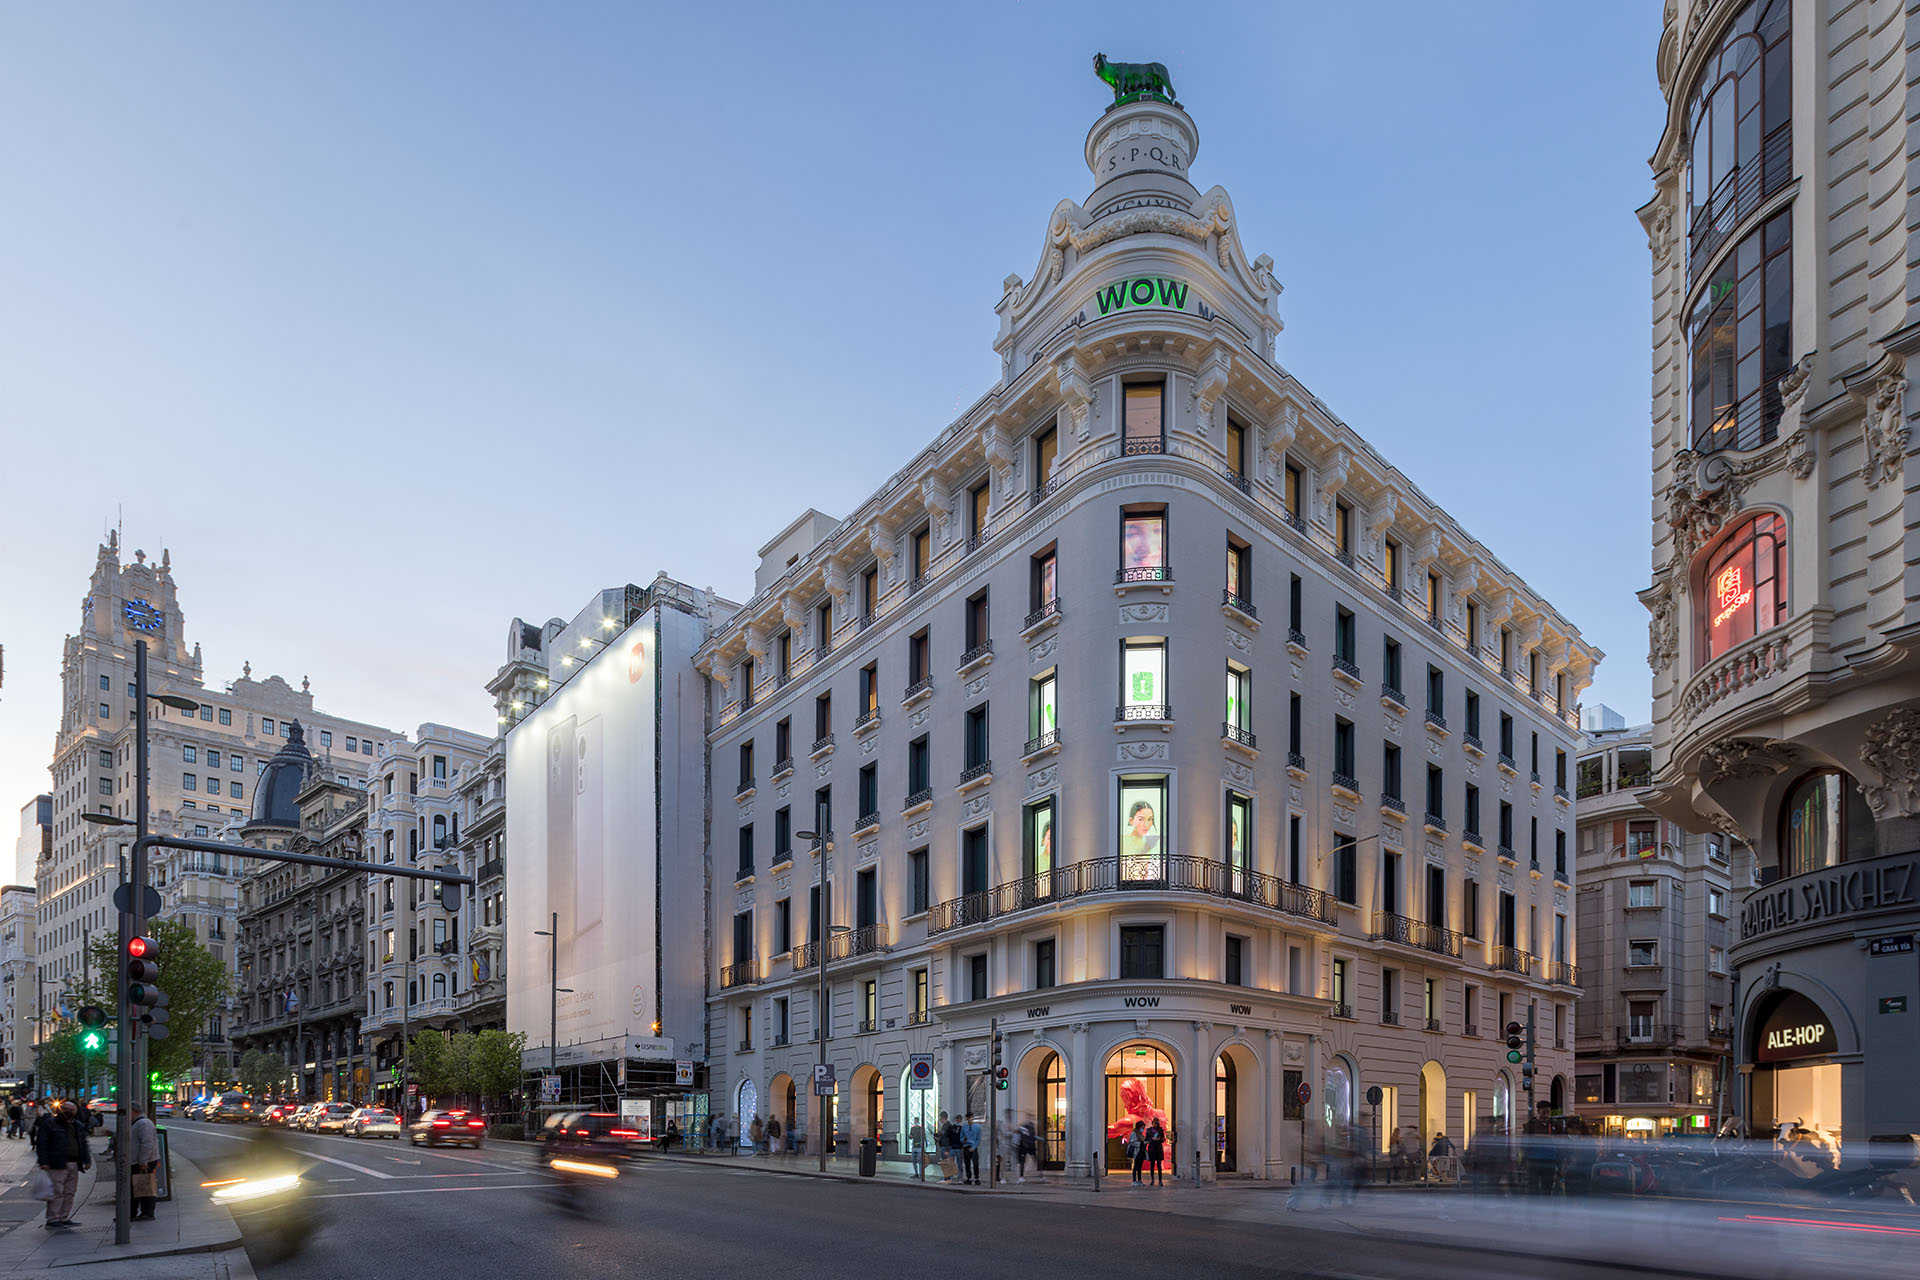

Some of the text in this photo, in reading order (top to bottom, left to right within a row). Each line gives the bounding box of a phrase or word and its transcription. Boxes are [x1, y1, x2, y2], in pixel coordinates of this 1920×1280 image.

[1095, 278, 1189, 315] WOW
[1744, 861, 1914, 938] RAFAEL SANCHEZ
[1881, 944, 1899, 953] GRAN
[1124, 997, 1160, 1007] WOW
[1230, 1003, 1252, 1015] WOW
[1026, 1006, 1050, 1018] WOW
[1767, 1023, 1825, 1049] ALE-HOP
[815, 1065, 827, 1081] P
